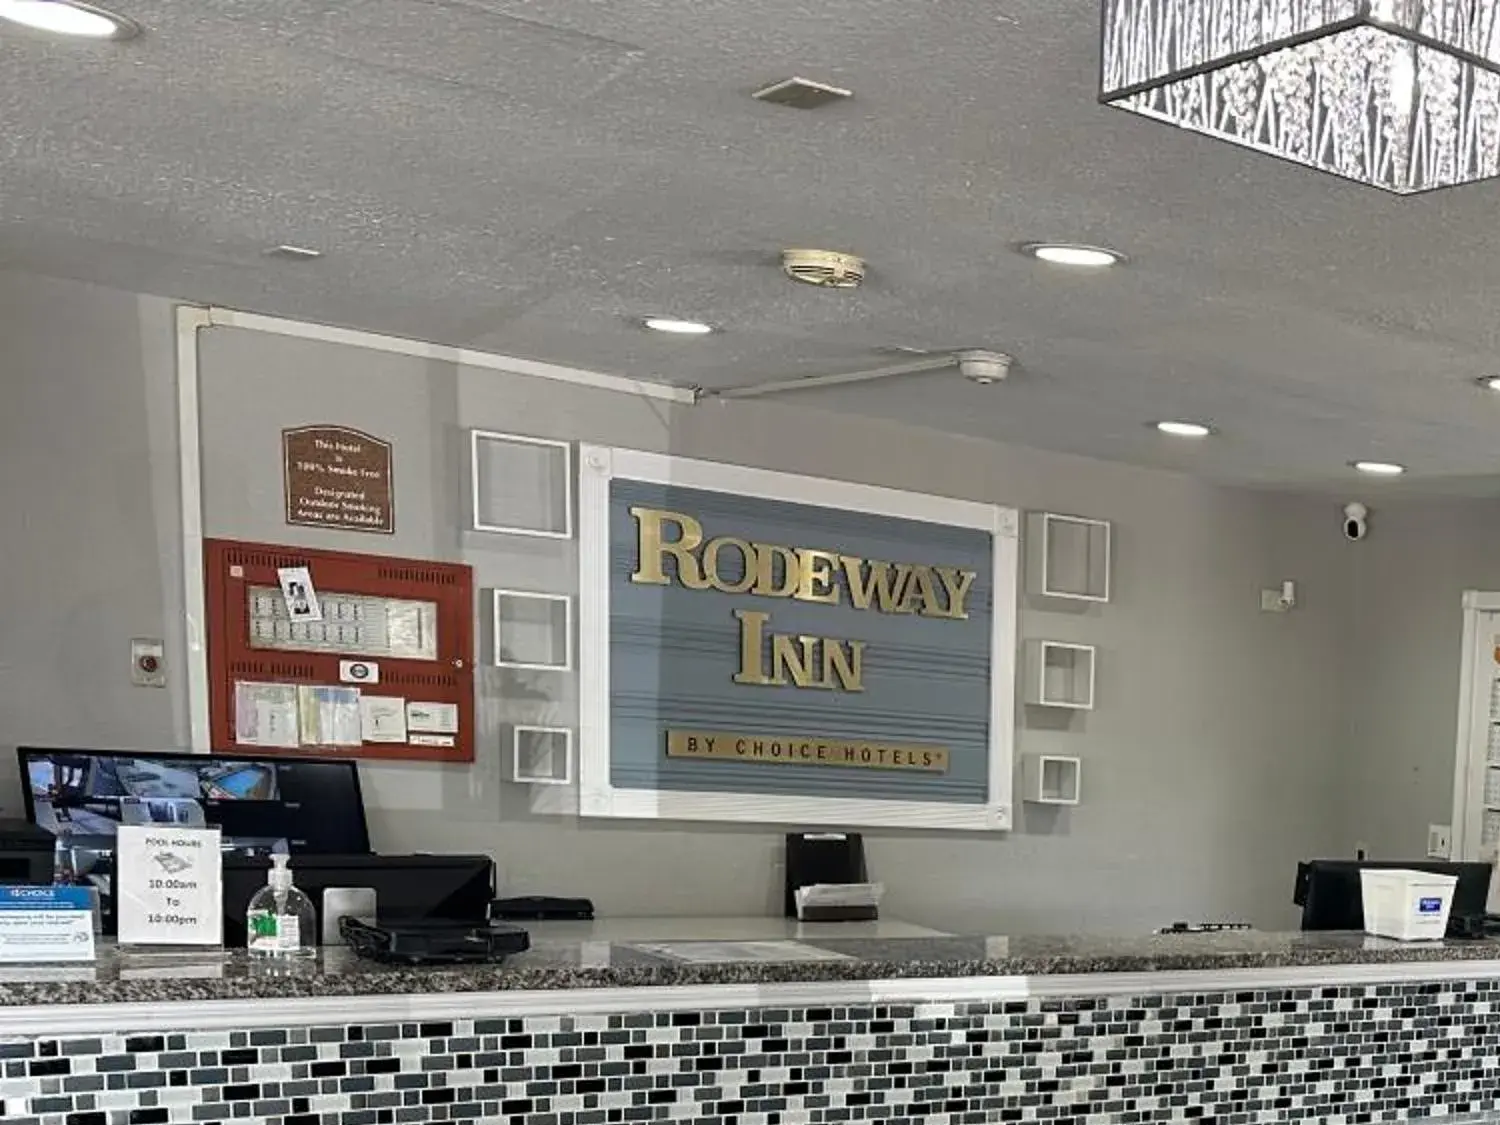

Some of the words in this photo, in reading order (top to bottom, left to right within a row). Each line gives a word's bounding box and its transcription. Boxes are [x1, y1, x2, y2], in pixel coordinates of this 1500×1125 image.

[629, 506, 977, 620] RODEWAY
[732, 608, 867, 693] INN
[687, 736, 716, 754] BY
[735, 739, 828, 762] CHOICE
[843, 744, 933, 767] HOTELS
